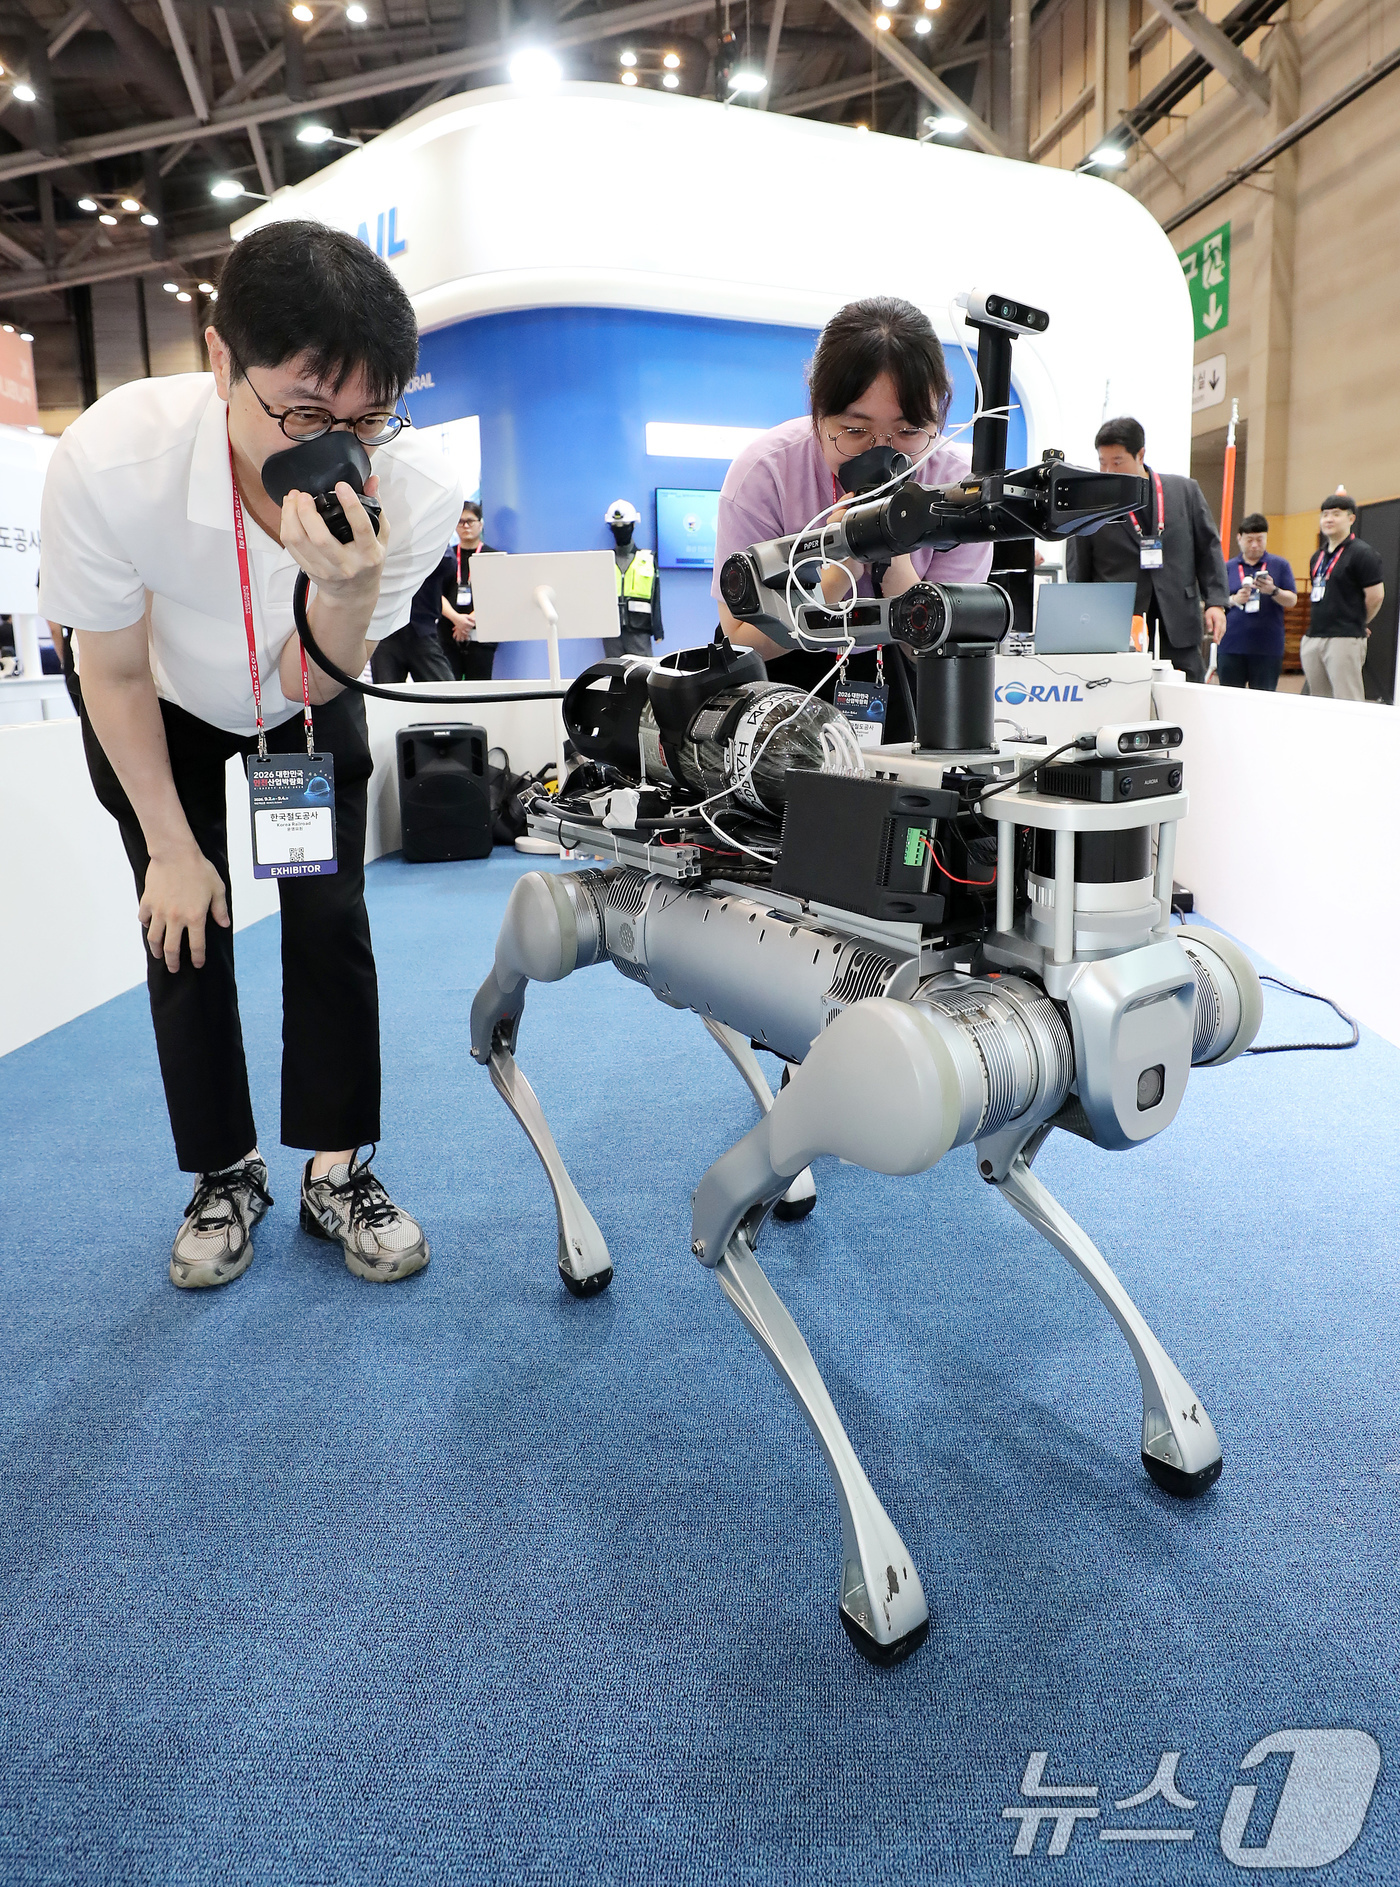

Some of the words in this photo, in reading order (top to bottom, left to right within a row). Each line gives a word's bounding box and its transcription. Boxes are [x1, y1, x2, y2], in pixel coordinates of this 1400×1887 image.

[403, 372, 436, 394] ORAIL
[253, 771, 274, 779] 2026
[275, 769, 304, 778] 대한민국
[270, 865, 321, 876] EXHIBITOR
